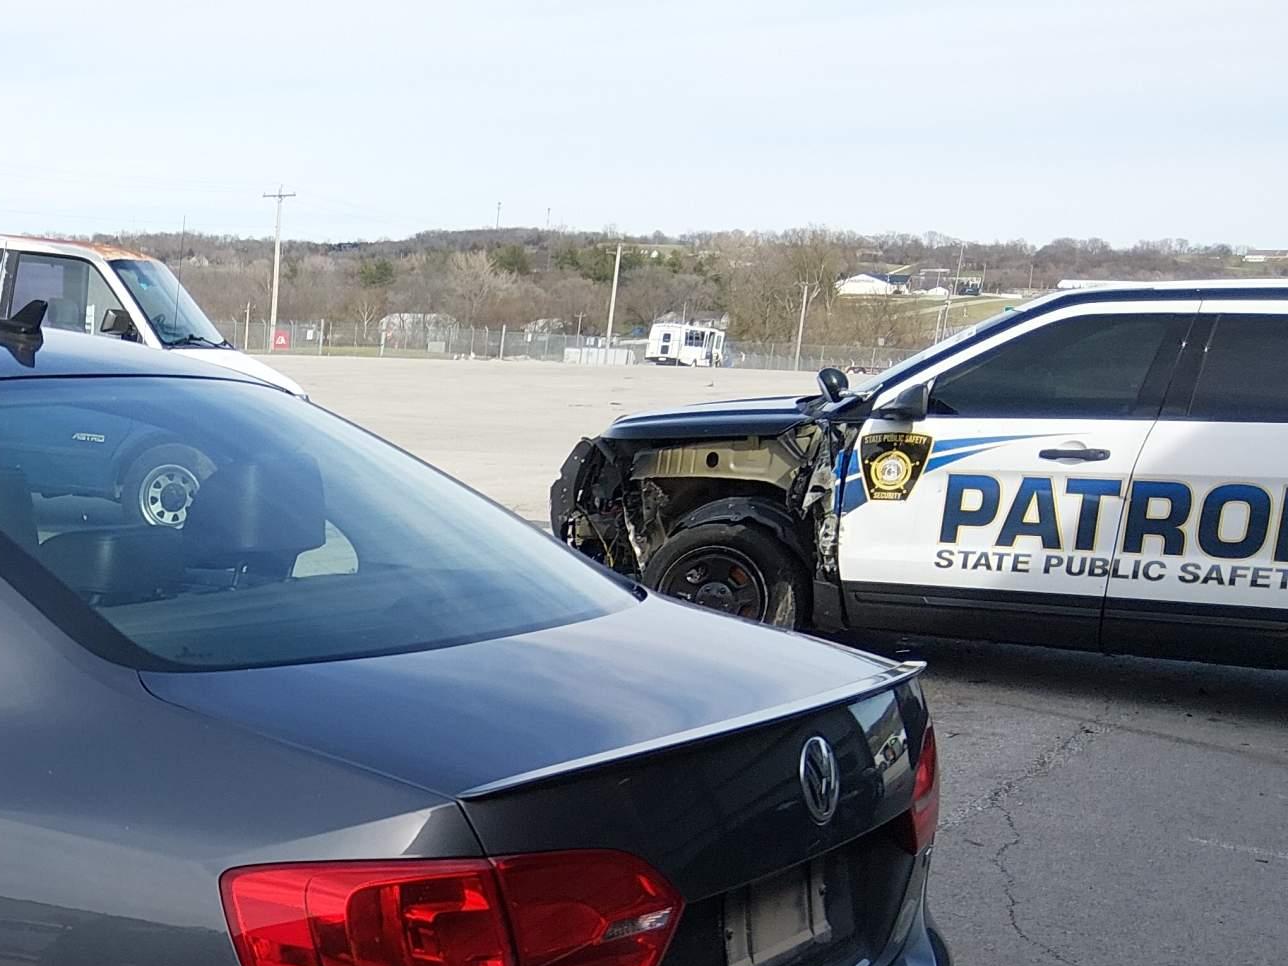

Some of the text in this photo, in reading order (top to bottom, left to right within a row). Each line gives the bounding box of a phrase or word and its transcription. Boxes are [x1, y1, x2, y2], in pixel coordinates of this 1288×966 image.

[72, 433, 104, 442] ASTRO
[864, 434, 927, 444] STATE PUBLIC SAFETY
[938, 473, 1288, 562] PATRO
[934, 549, 1032, 573] STATE
[1043, 555, 1167, 581] PUBLIC
